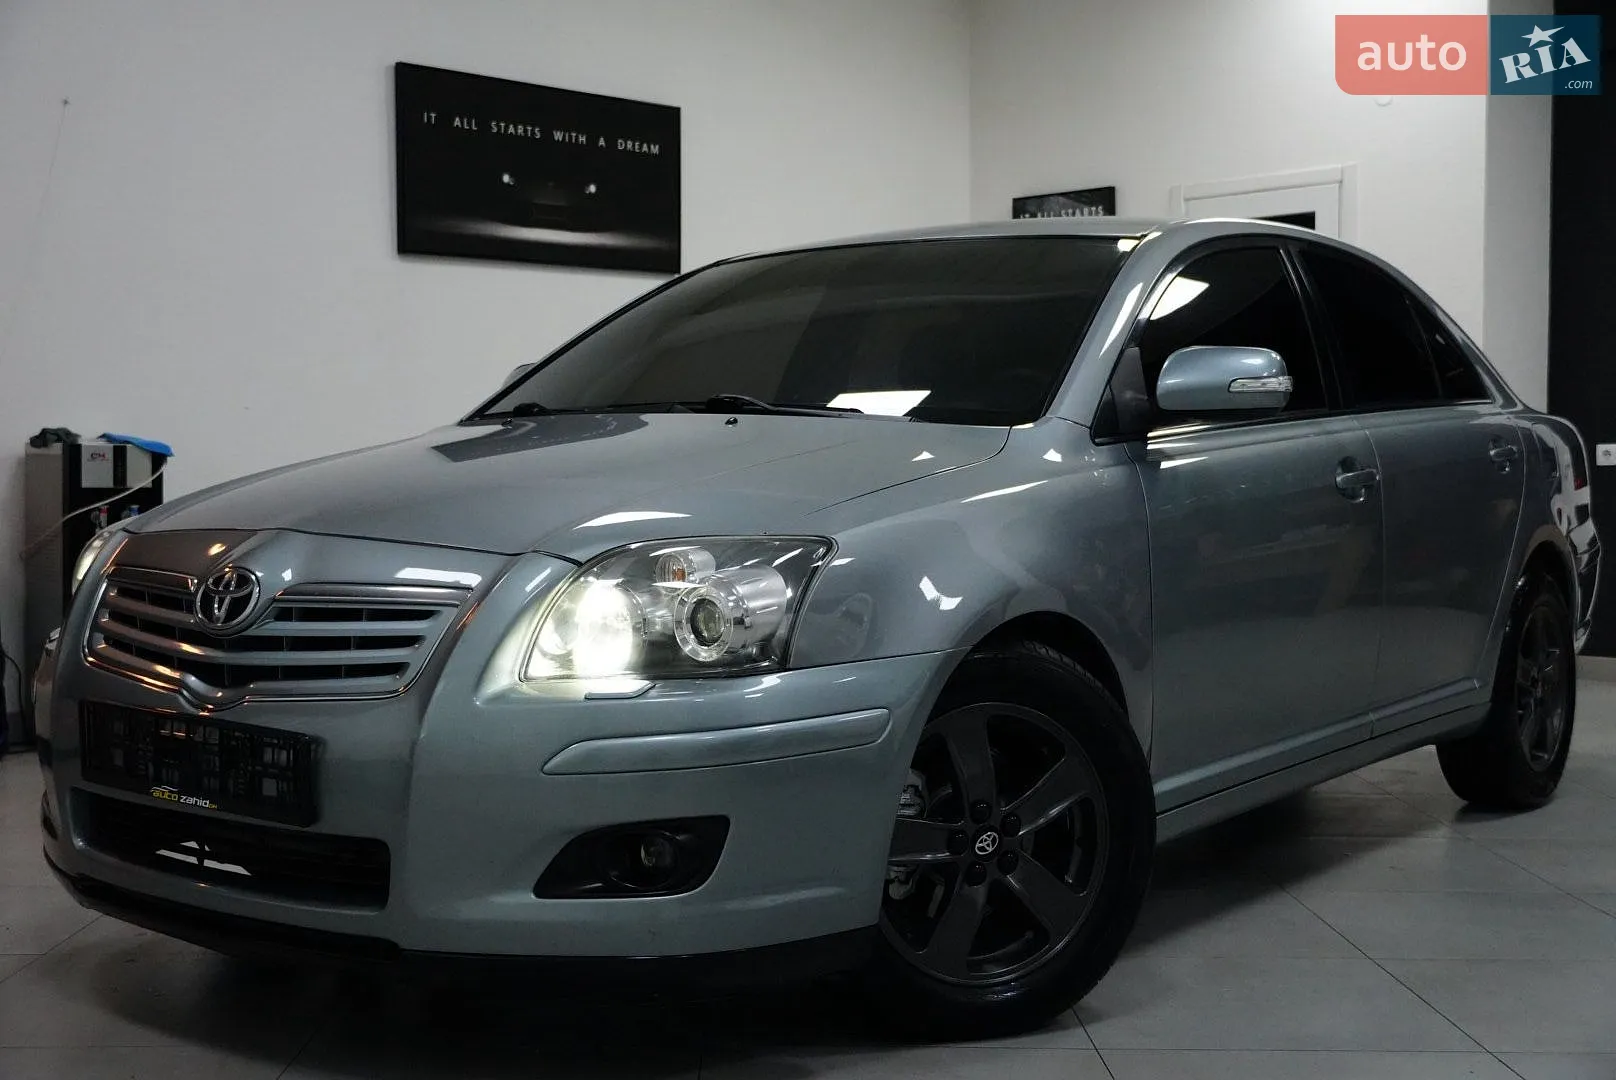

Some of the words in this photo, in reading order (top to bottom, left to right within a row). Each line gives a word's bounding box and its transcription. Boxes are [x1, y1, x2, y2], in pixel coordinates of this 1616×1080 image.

[423, 112, 437, 124] IT
[453, 116, 478, 130] ALL
[490, 121, 541, 139] STARTS
[553, 129, 587, 145] WITH
[598, 137, 606, 148] A
[617, 139, 660, 155] DREAM
[1061, 205, 1103, 218] STARTS
[180, 795, 210, 808] zahid
